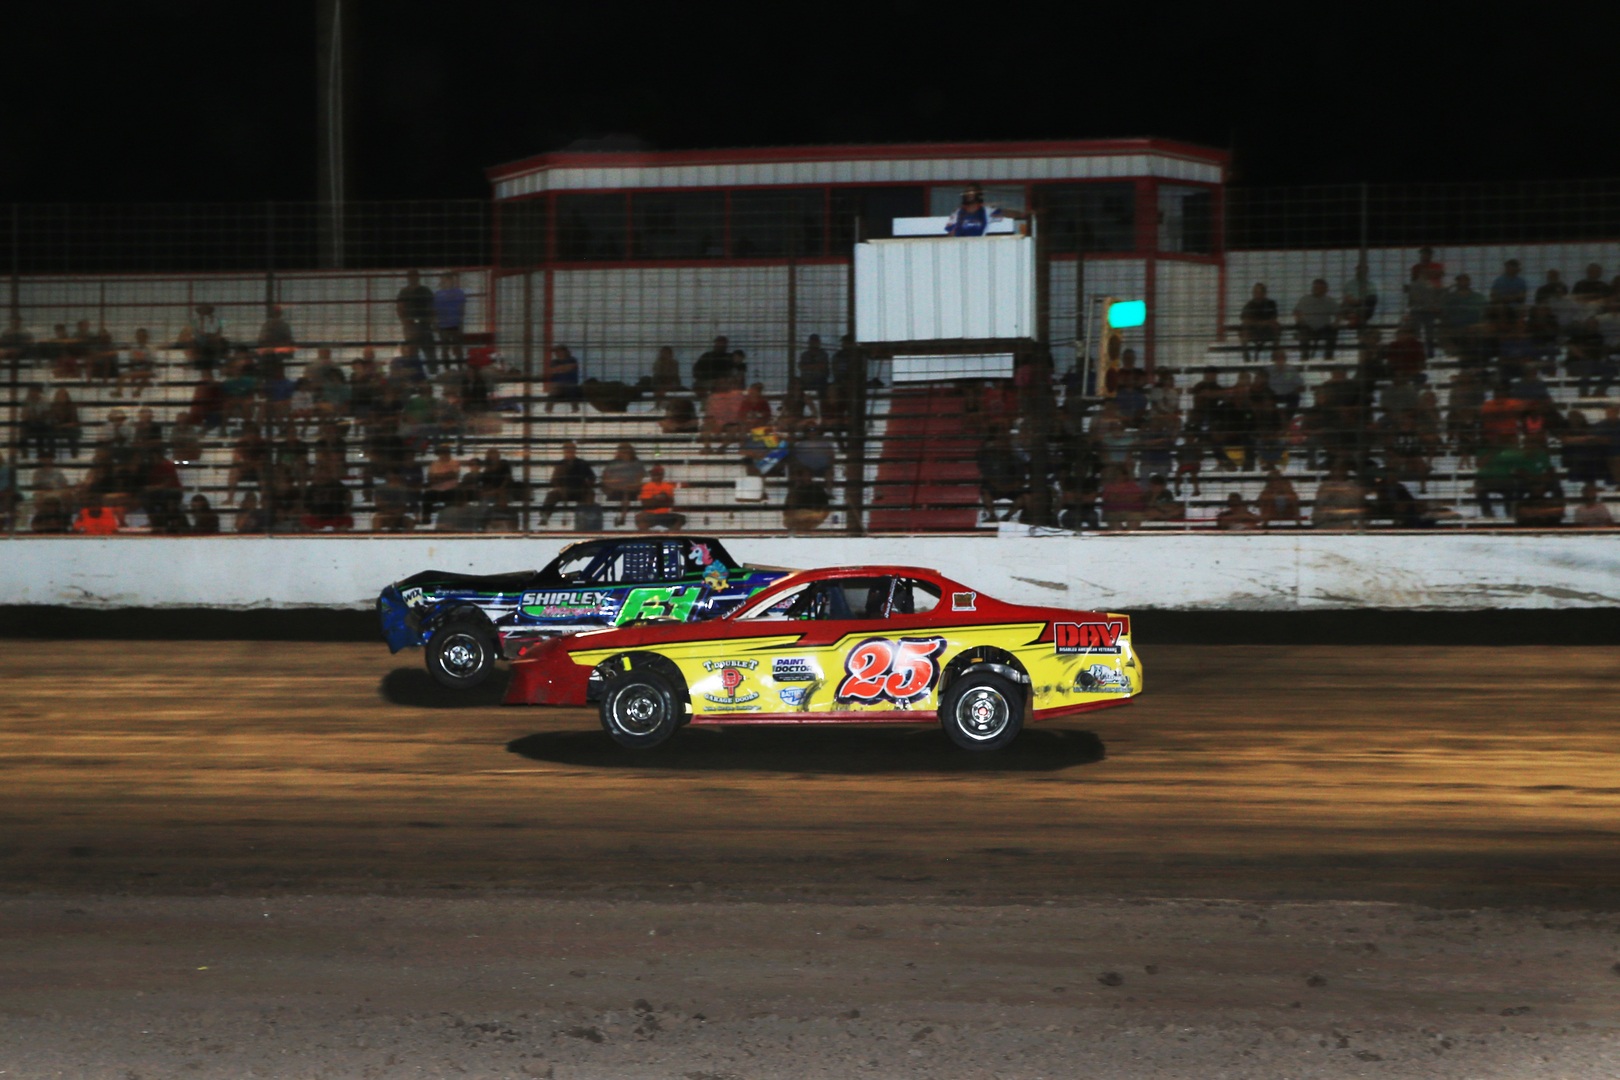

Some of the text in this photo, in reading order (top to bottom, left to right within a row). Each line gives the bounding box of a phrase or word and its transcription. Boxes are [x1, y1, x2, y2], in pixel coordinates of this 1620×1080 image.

[404, 589, 421, 602] WIX
[522, 592, 607, 605] SHIPLEY
[1057, 624, 1120, 647] DAV
[713, 660, 748, 669] DOUBLE
[836, 637, 944, 702] 25
[704, 691, 759, 703] GARAGE DOORS
